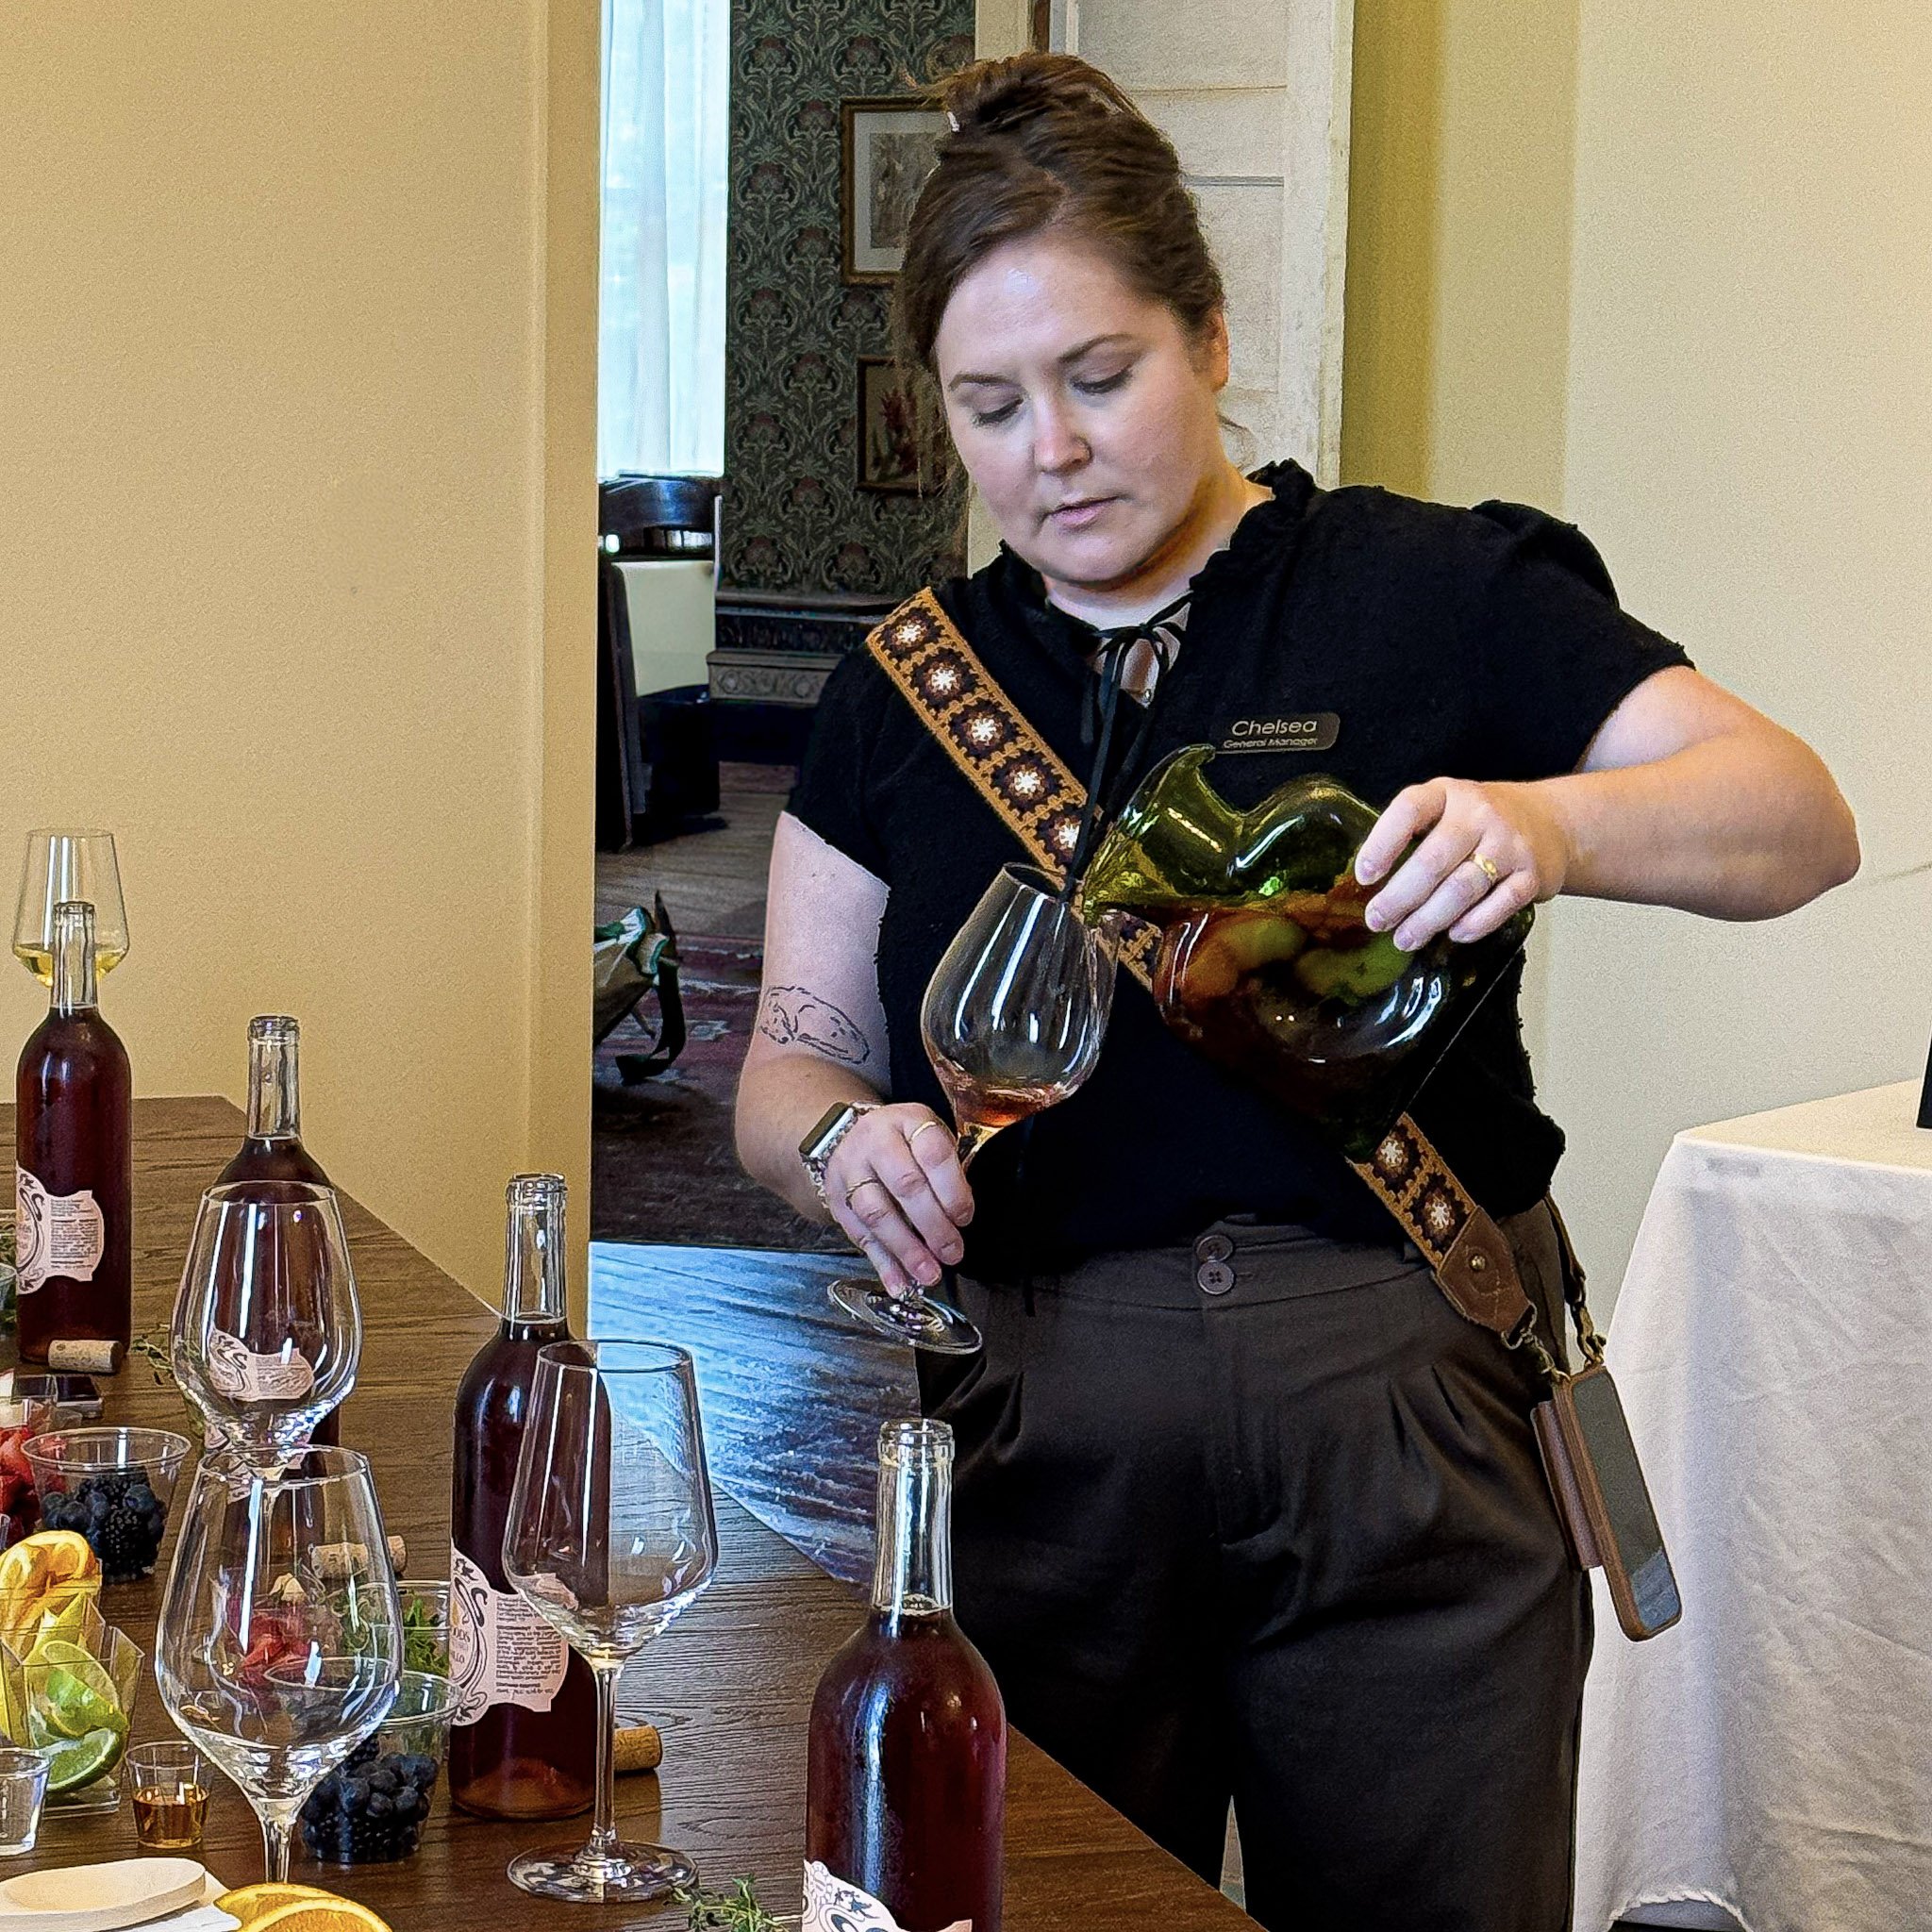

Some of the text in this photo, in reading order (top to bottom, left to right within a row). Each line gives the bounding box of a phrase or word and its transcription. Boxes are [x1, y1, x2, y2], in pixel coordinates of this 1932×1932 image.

[1232, 719, 1317, 736] Chelsea
[1224, 738, 1318, 748] General Manager
